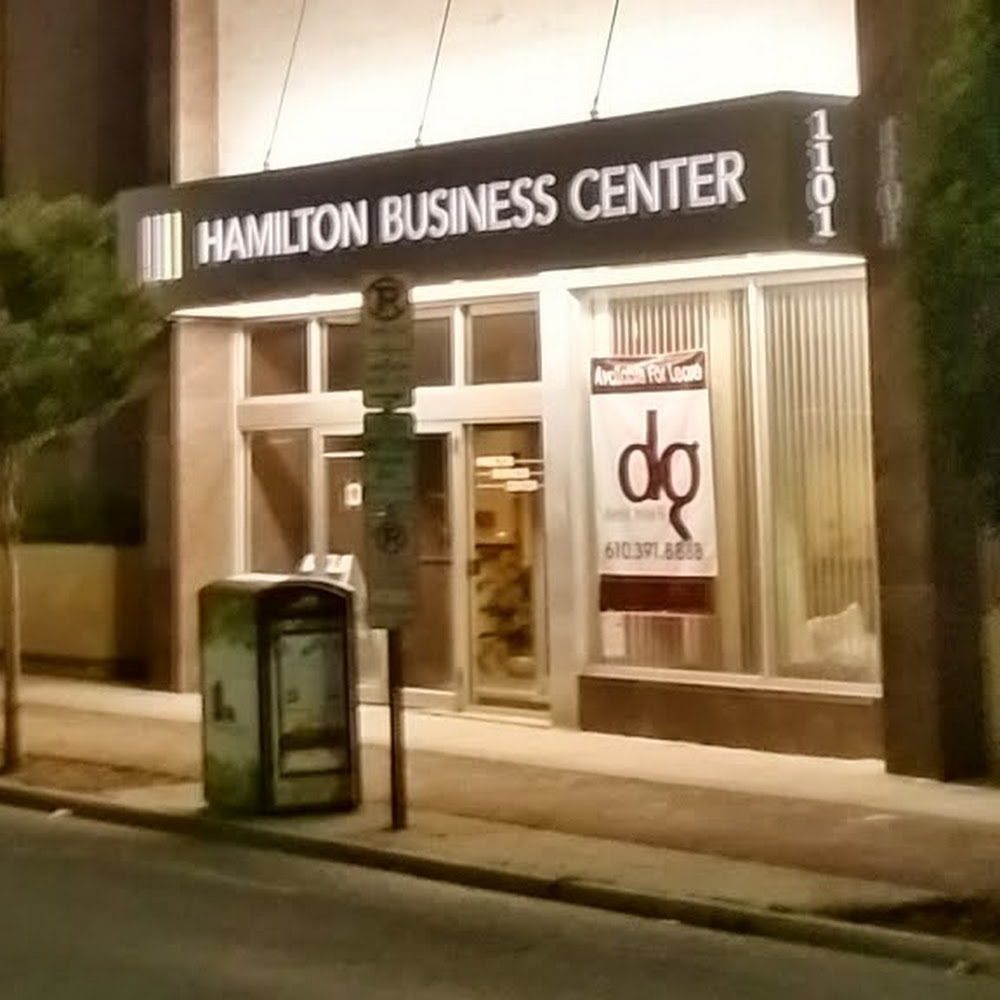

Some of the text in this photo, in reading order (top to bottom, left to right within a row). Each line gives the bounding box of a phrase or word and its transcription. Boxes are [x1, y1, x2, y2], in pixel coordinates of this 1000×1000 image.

[195, 150, 747, 265] HAMILTON BUSINESS CENTER
[811, 108, 837, 238] 1101
